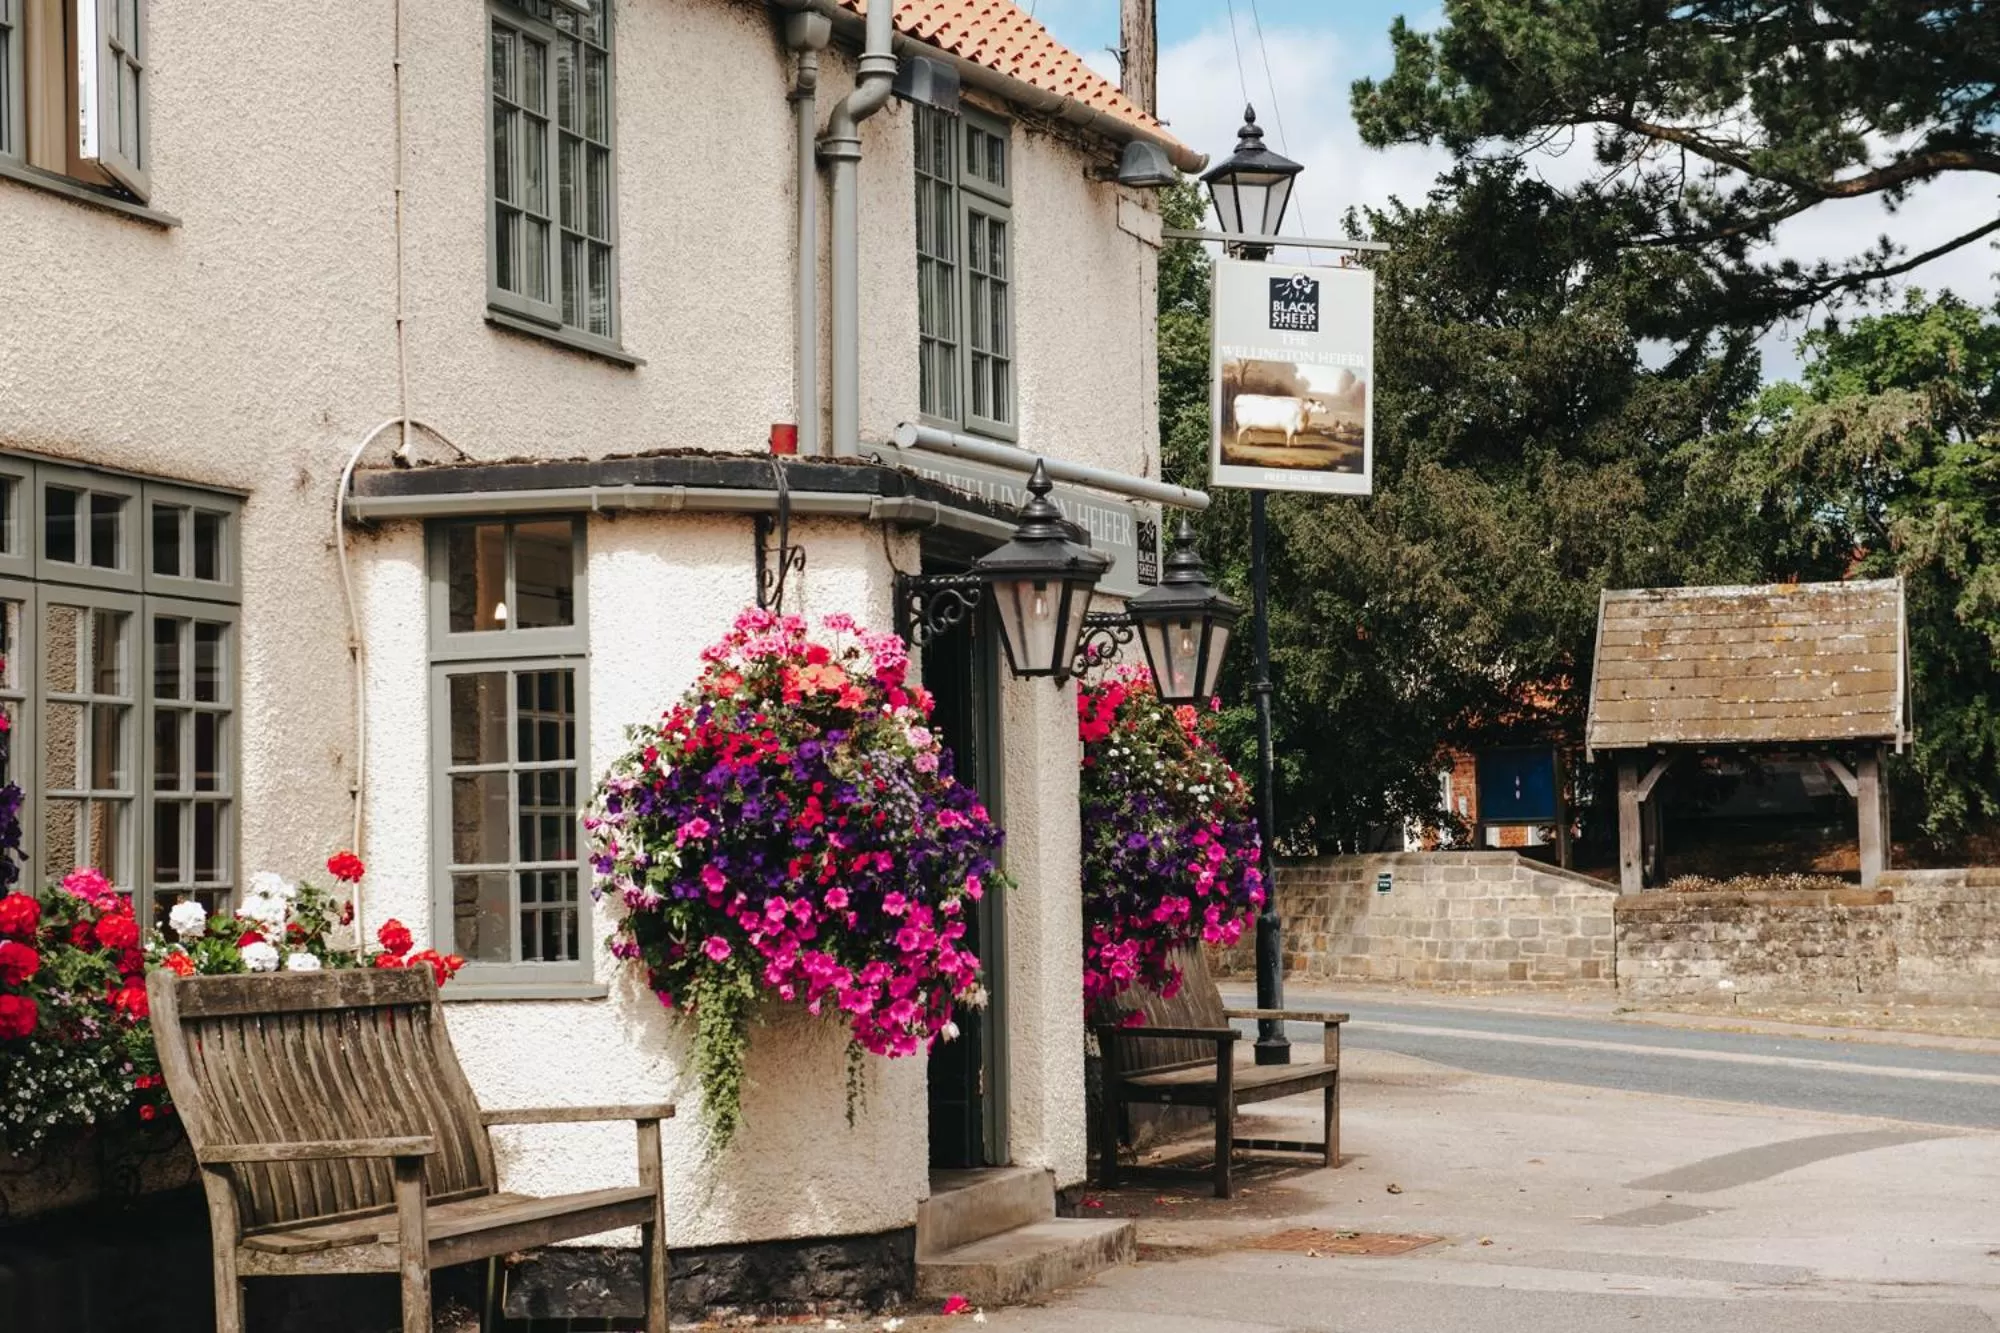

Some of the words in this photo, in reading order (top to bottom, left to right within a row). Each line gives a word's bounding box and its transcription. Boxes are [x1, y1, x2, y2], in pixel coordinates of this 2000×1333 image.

[1272, 300, 1317, 314] BLACK
[1271, 311, 1317, 325] SHEEP
[1279, 332, 1309, 345] THE
[1222, 345, 1314, 363] WELLINGTON
[1317, 351, 1366, 368] HEIFER
[945, 472, 1073, 520] WELLINN
[1077, 503, 1132, 547] HEIFER
